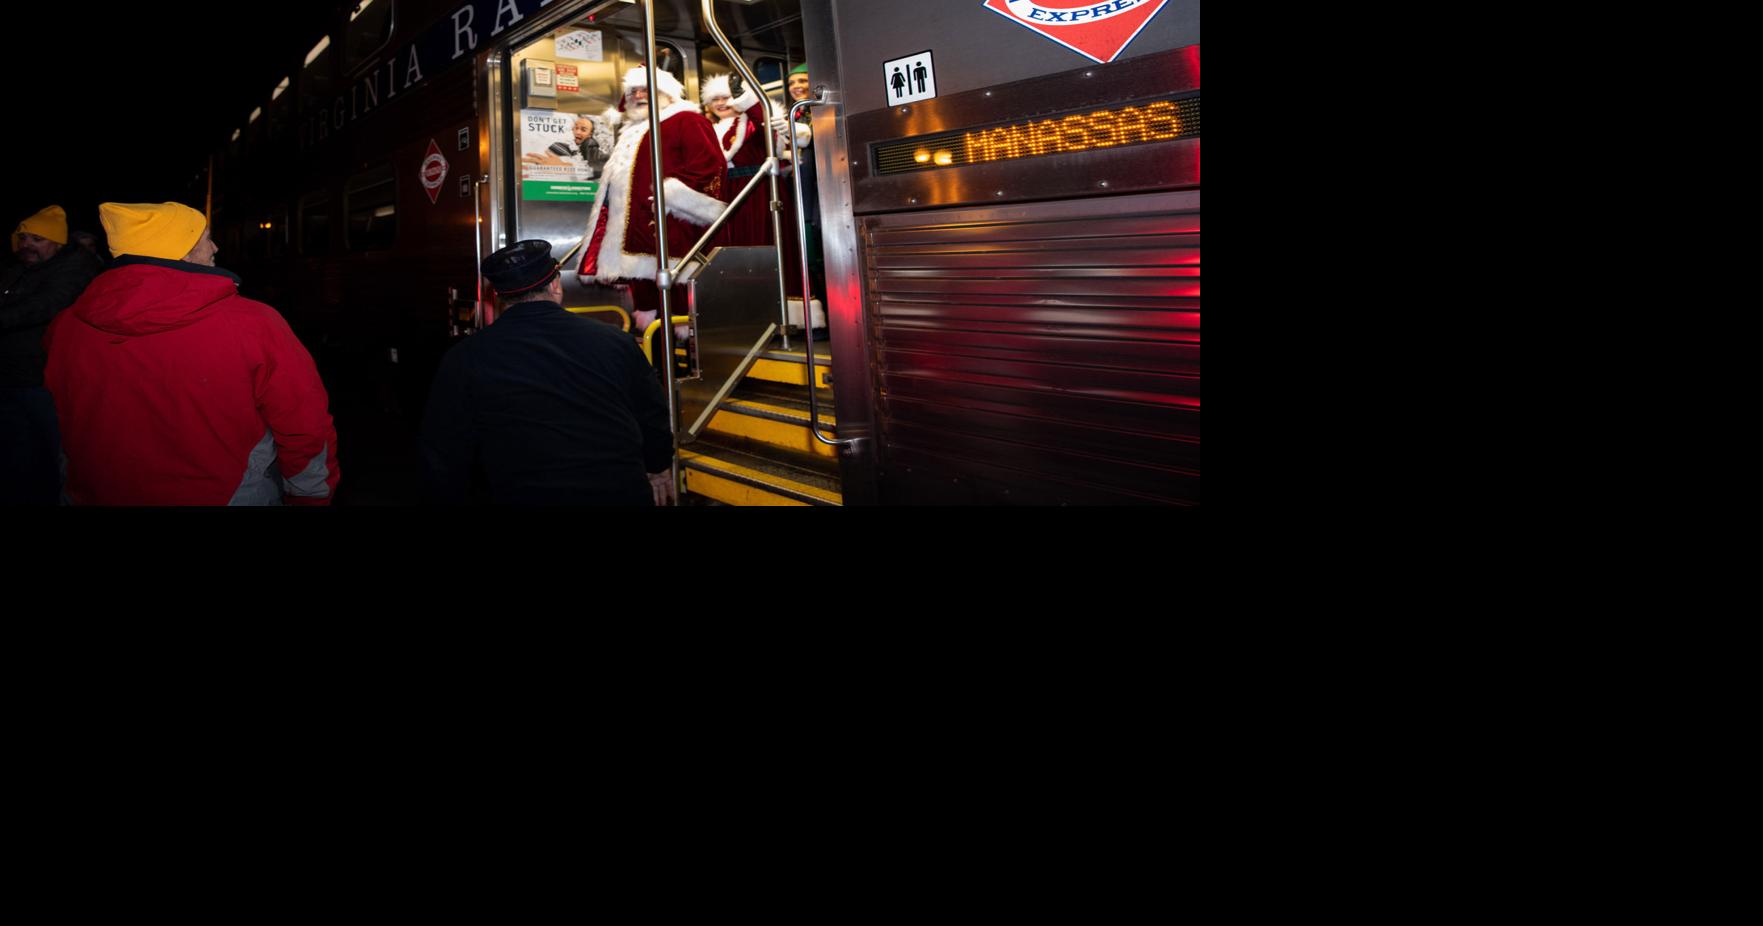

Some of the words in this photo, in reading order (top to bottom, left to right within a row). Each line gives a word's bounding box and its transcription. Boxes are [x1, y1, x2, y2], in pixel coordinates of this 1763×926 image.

[1028, 0, 1141, 22] EXPRE
[299, 44, 423, 149] VIRGINIA
[451, 0, 554, 60] RA
[528, 116, 550, 124] DON'T
[528, 123, 565, 133] STUCK
[965, 101, 1180, 163] MANASSAS
